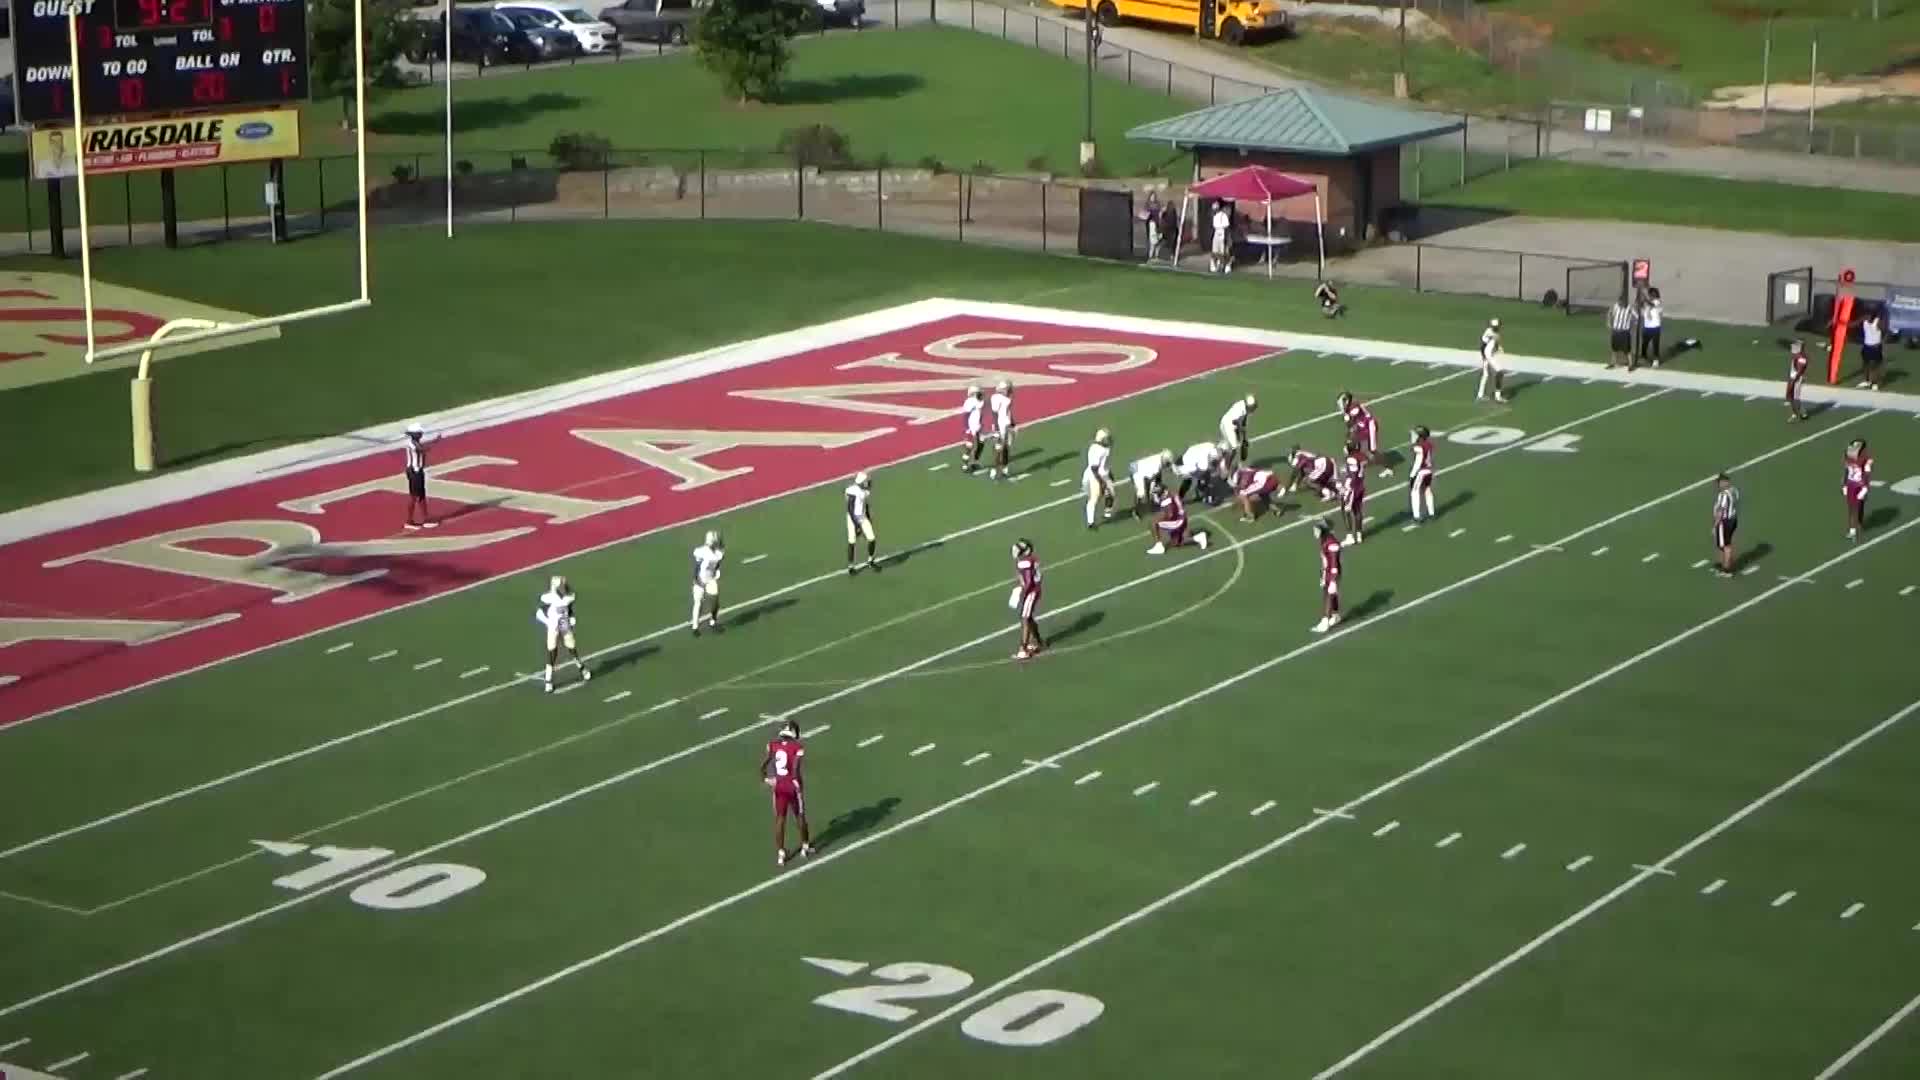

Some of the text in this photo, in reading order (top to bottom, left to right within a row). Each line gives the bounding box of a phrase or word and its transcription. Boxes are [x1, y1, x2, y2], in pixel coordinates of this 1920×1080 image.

[192, 29, 215, 42] TOL
[103, 59, 147, 75] TO GO
[176, 52, 240, 70] BALL ON
[88, 119, 224, 152] RAGSDALE
[775, 749, 789, 776] 2
[272, 844, 488, 910] 10
[812, 961, 1105, 1047] 20
